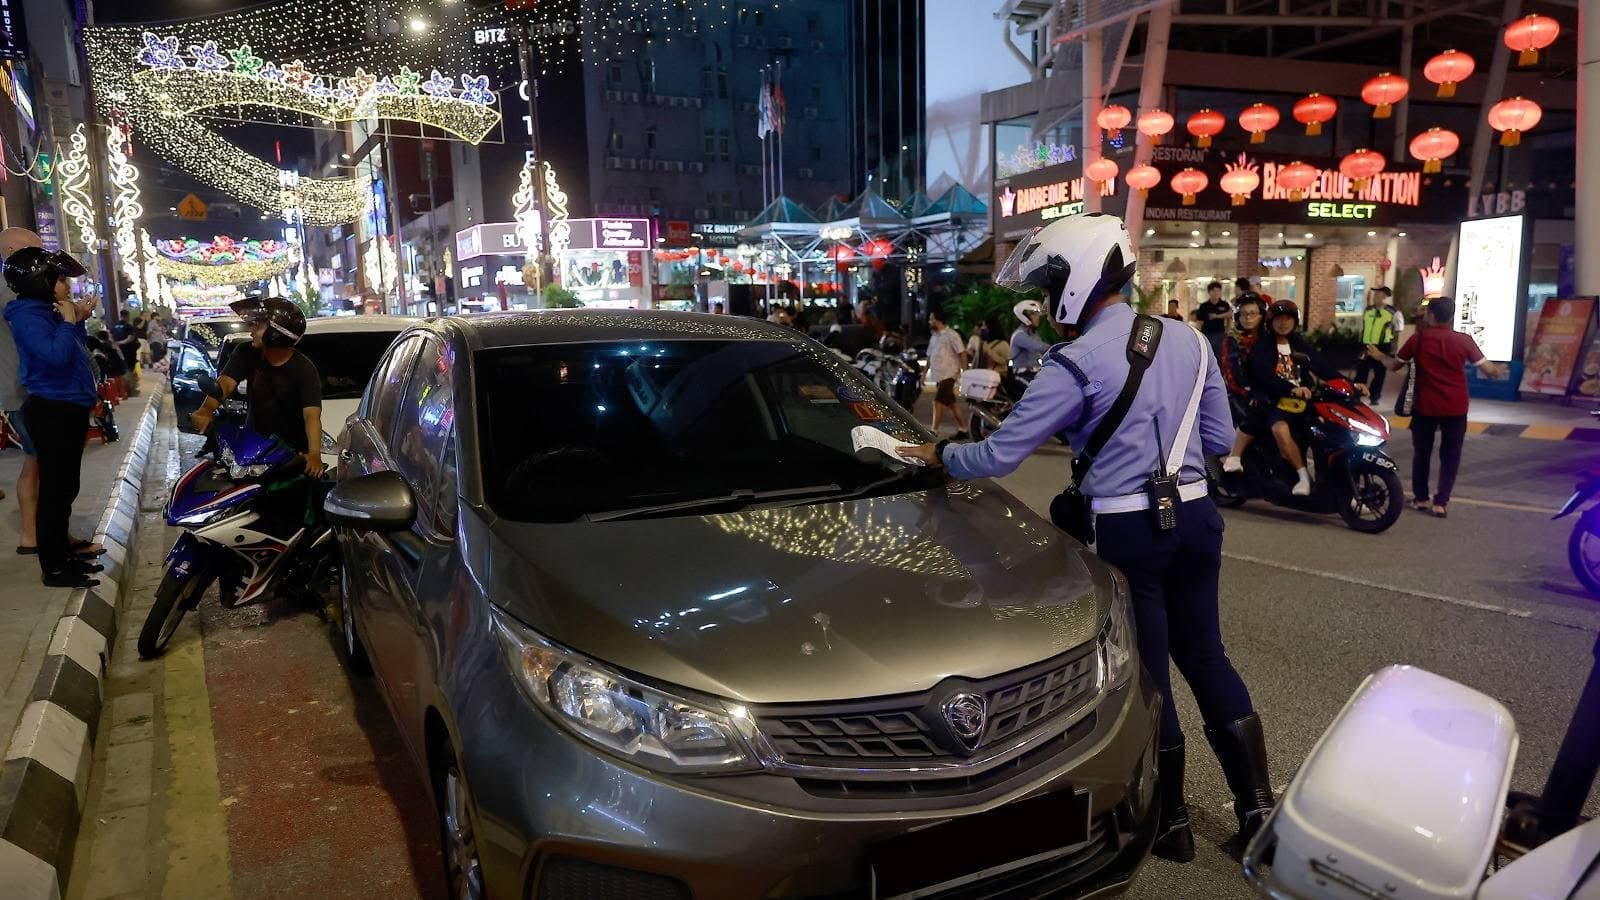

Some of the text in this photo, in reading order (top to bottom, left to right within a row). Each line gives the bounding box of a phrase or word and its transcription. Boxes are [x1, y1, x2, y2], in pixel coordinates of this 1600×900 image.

[3, 10, 14, 47] HOTL
[474, 27, 507, 45] BITZ
[1263, 162, 1354, 200] BAEQUE
[1016, 182, 1069, 214] BARBEQUE
[1041, 202, 1085, 220] SELECT
[1145, 207, 1232, 220] INDIAN RESTAURANT
[1307, 202, 1377, 219] SELECT
[1141, 325, 1153, 343] DBKL
